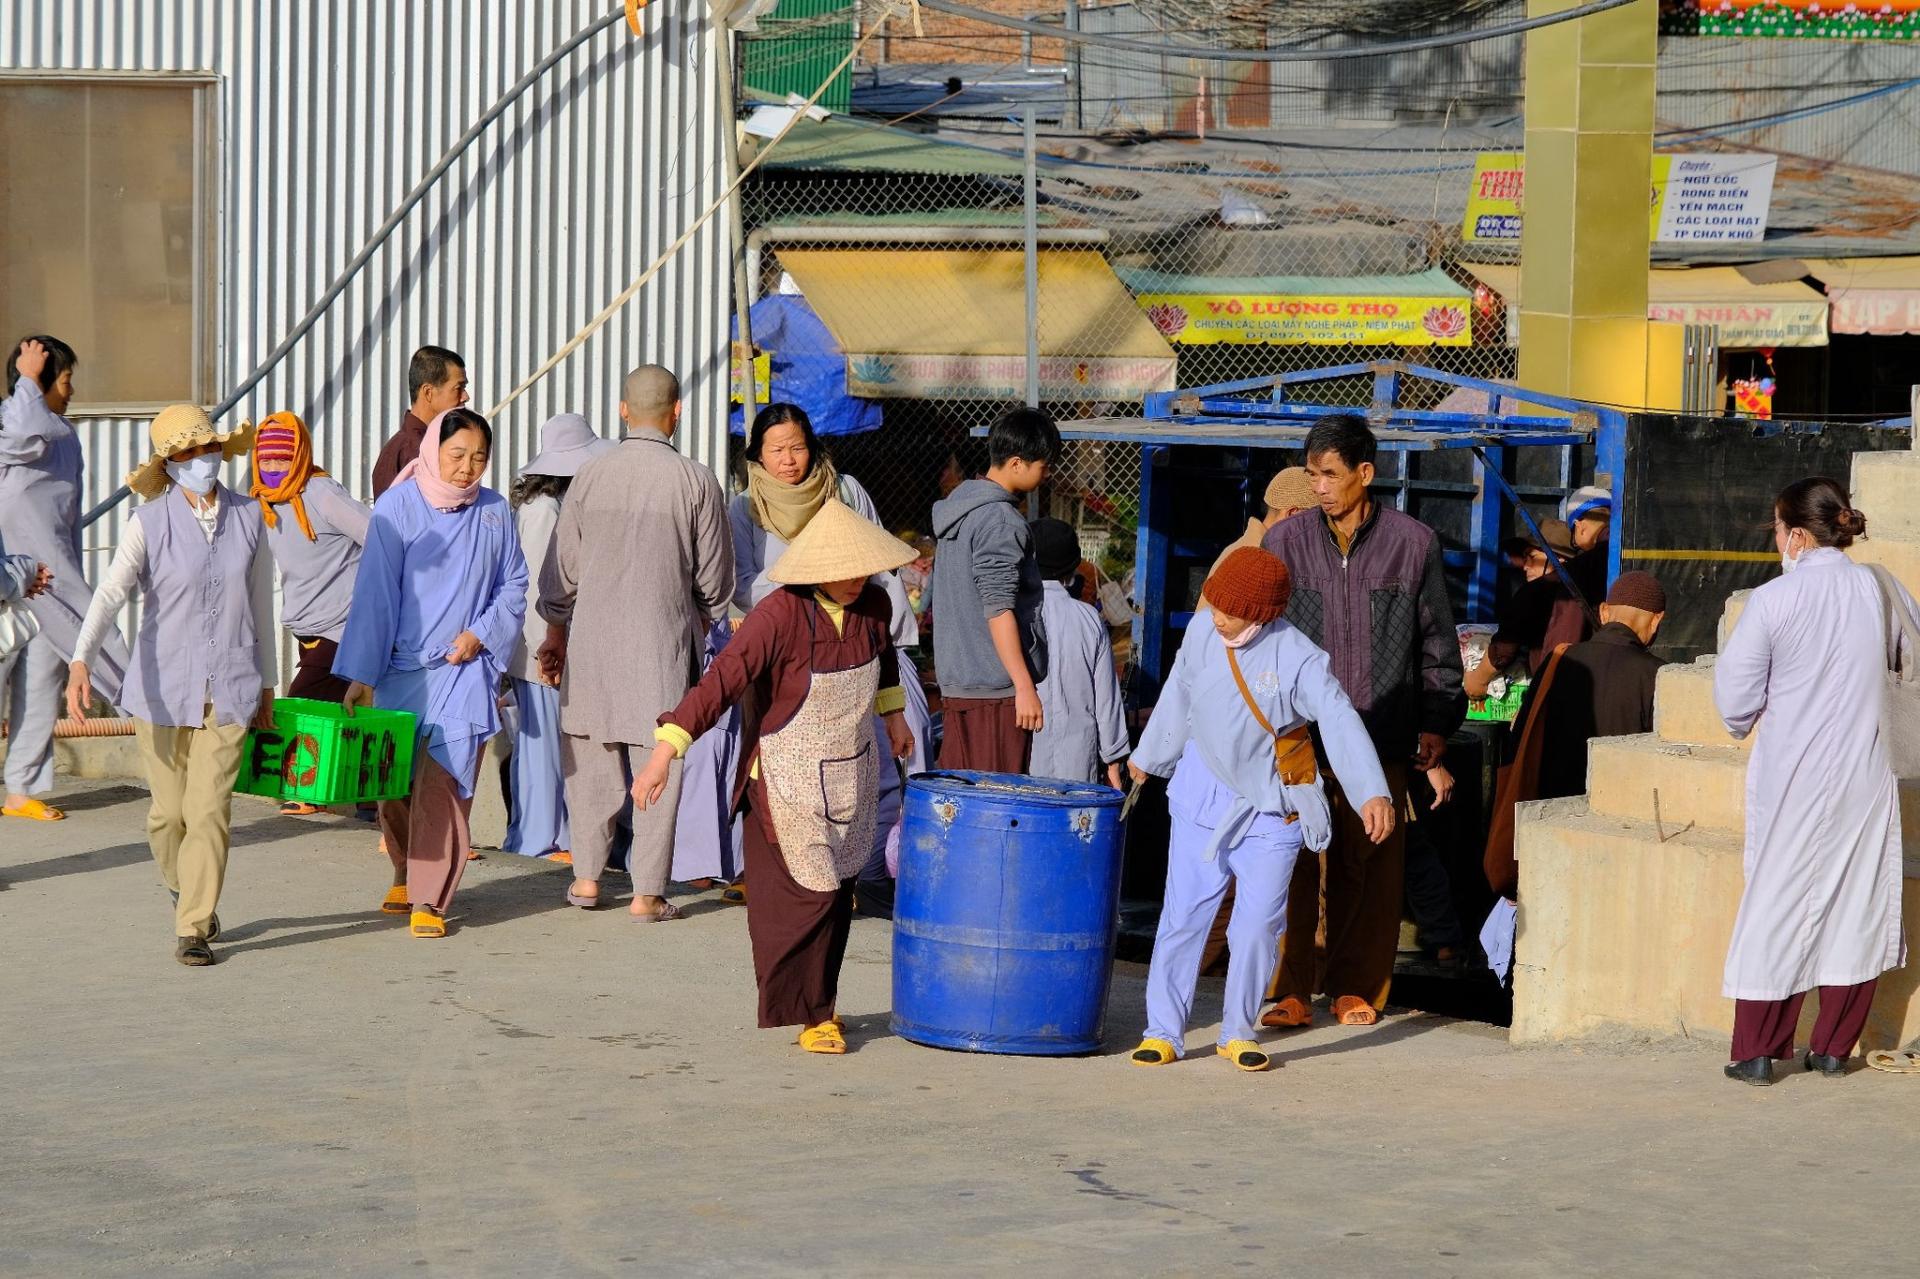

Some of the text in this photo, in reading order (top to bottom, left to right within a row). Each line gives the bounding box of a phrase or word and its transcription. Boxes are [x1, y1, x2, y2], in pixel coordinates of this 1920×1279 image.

[1675, 230, 1688, 238] TP
[1206, 299, 1243, 314] VÔ
[1348, 303, 1398, 317] THỌ
[1194, 318, 1232, 329] CHUYÊN
[1304, 320, 1330, 330] NGHE
